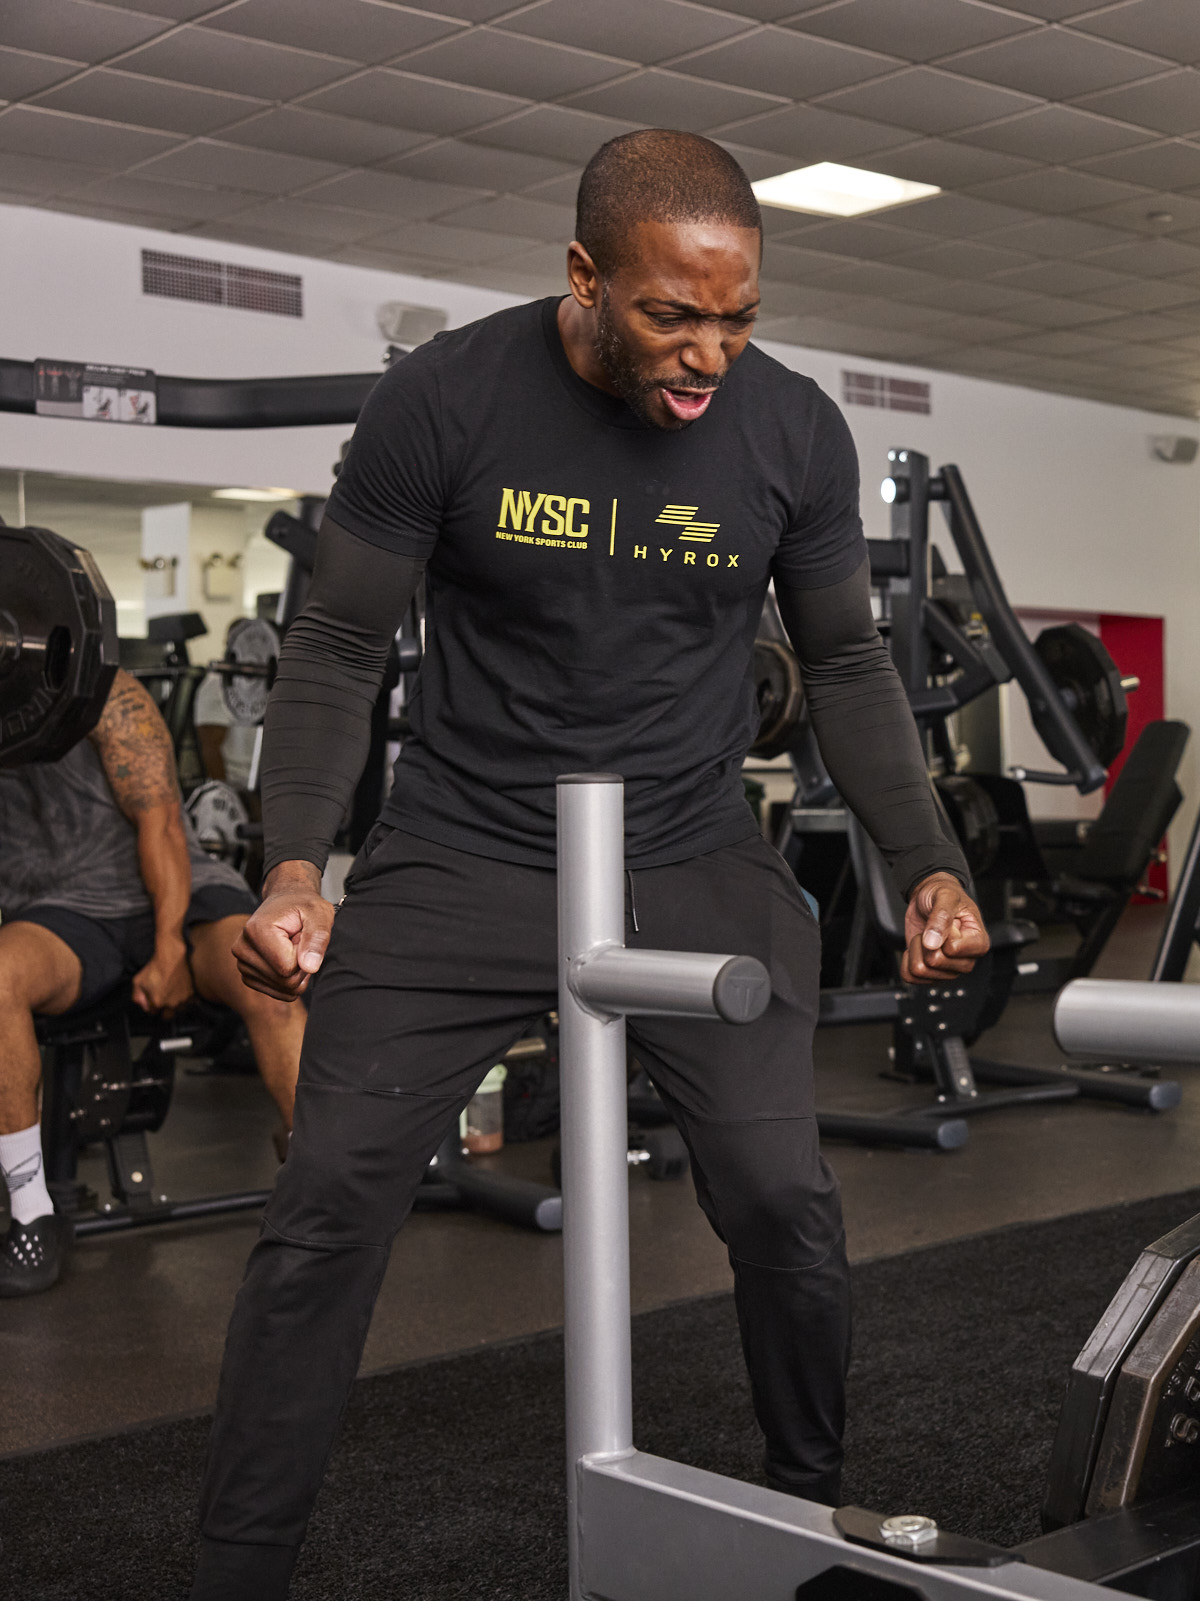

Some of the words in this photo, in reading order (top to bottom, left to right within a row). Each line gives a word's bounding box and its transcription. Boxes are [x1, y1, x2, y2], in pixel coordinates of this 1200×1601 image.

[497, 487, 590, 538] NYSC
[495, 531, 513, 541] NEW
[514, 534, 535, 544] YORK
[535, 537, 566, 548] SPORTS
[567, 541, 588, 549] CLUB
[633, 544, 740, 568] HYROX
